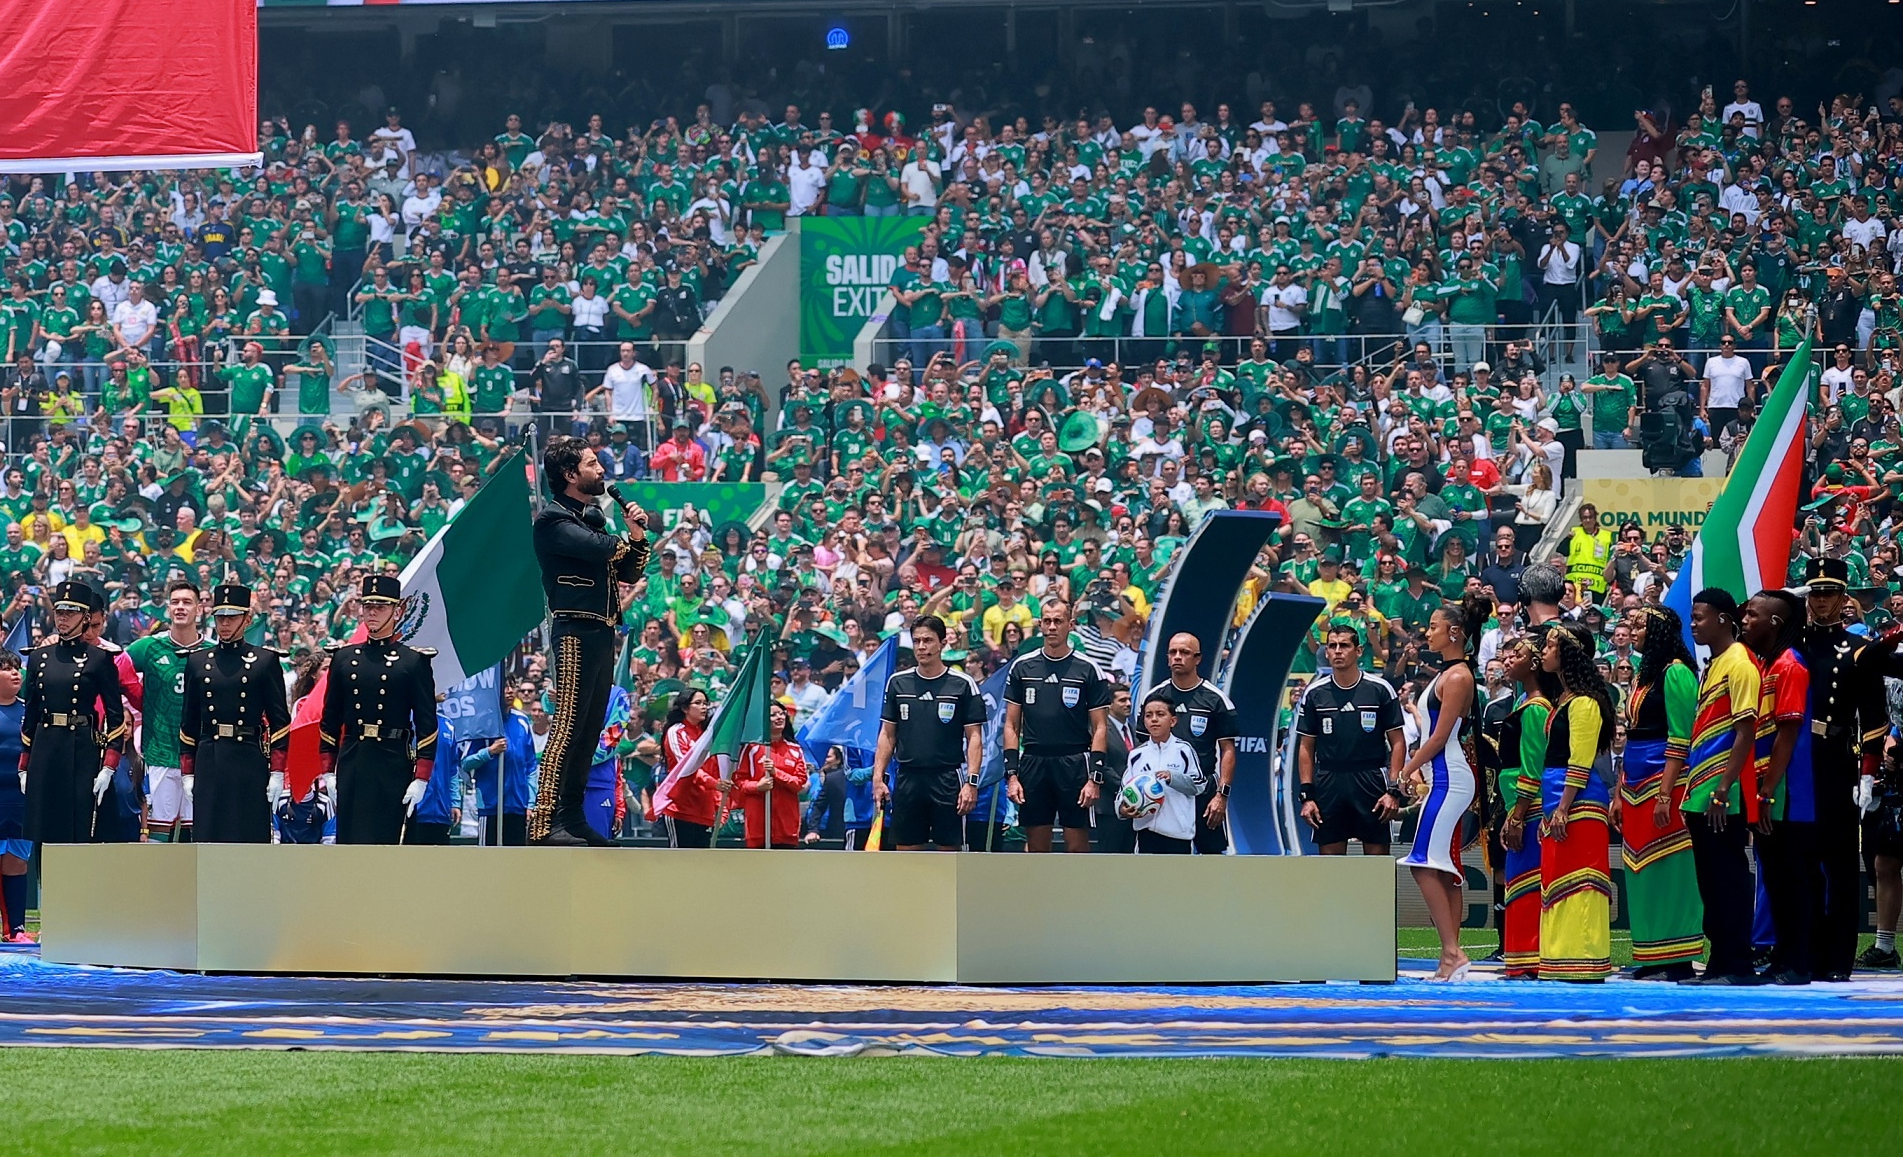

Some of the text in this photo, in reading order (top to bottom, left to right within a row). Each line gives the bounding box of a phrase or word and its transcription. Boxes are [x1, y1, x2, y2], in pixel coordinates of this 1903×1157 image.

[826, 254, 897, 285] SALID
[485, 380, 494, 391] 9
[1599, 511, 1644, 528] OPA
[1571, 562, 1604, 576] ECURITY
[174, 673, 185, 695] 3
[1234, 736, 1267, 753] FIFA
